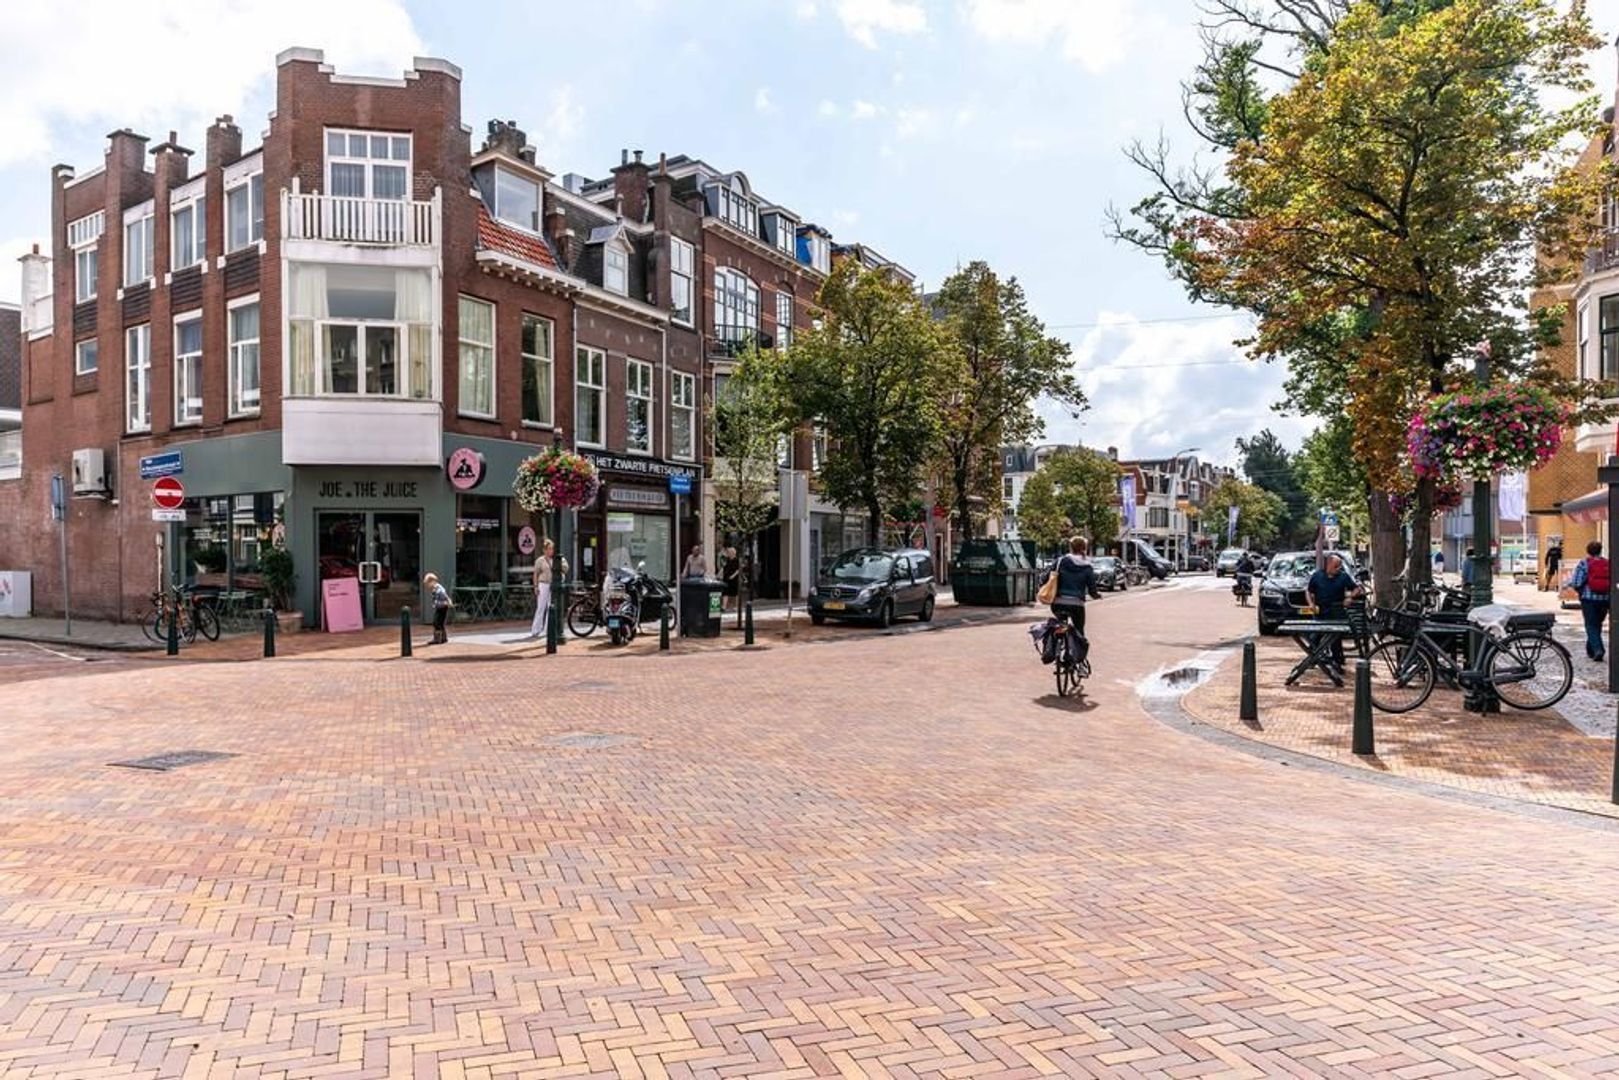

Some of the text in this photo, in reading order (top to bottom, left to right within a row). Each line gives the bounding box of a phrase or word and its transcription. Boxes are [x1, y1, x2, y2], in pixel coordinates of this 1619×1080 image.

[596, 457, 612, 467] HET
[615, 459, 647, 472] ZWARTE
[319, 482, 342, 497] JOE
[354, 482, 377, 497] THE
[383, 482, 417, 497] JUICE
